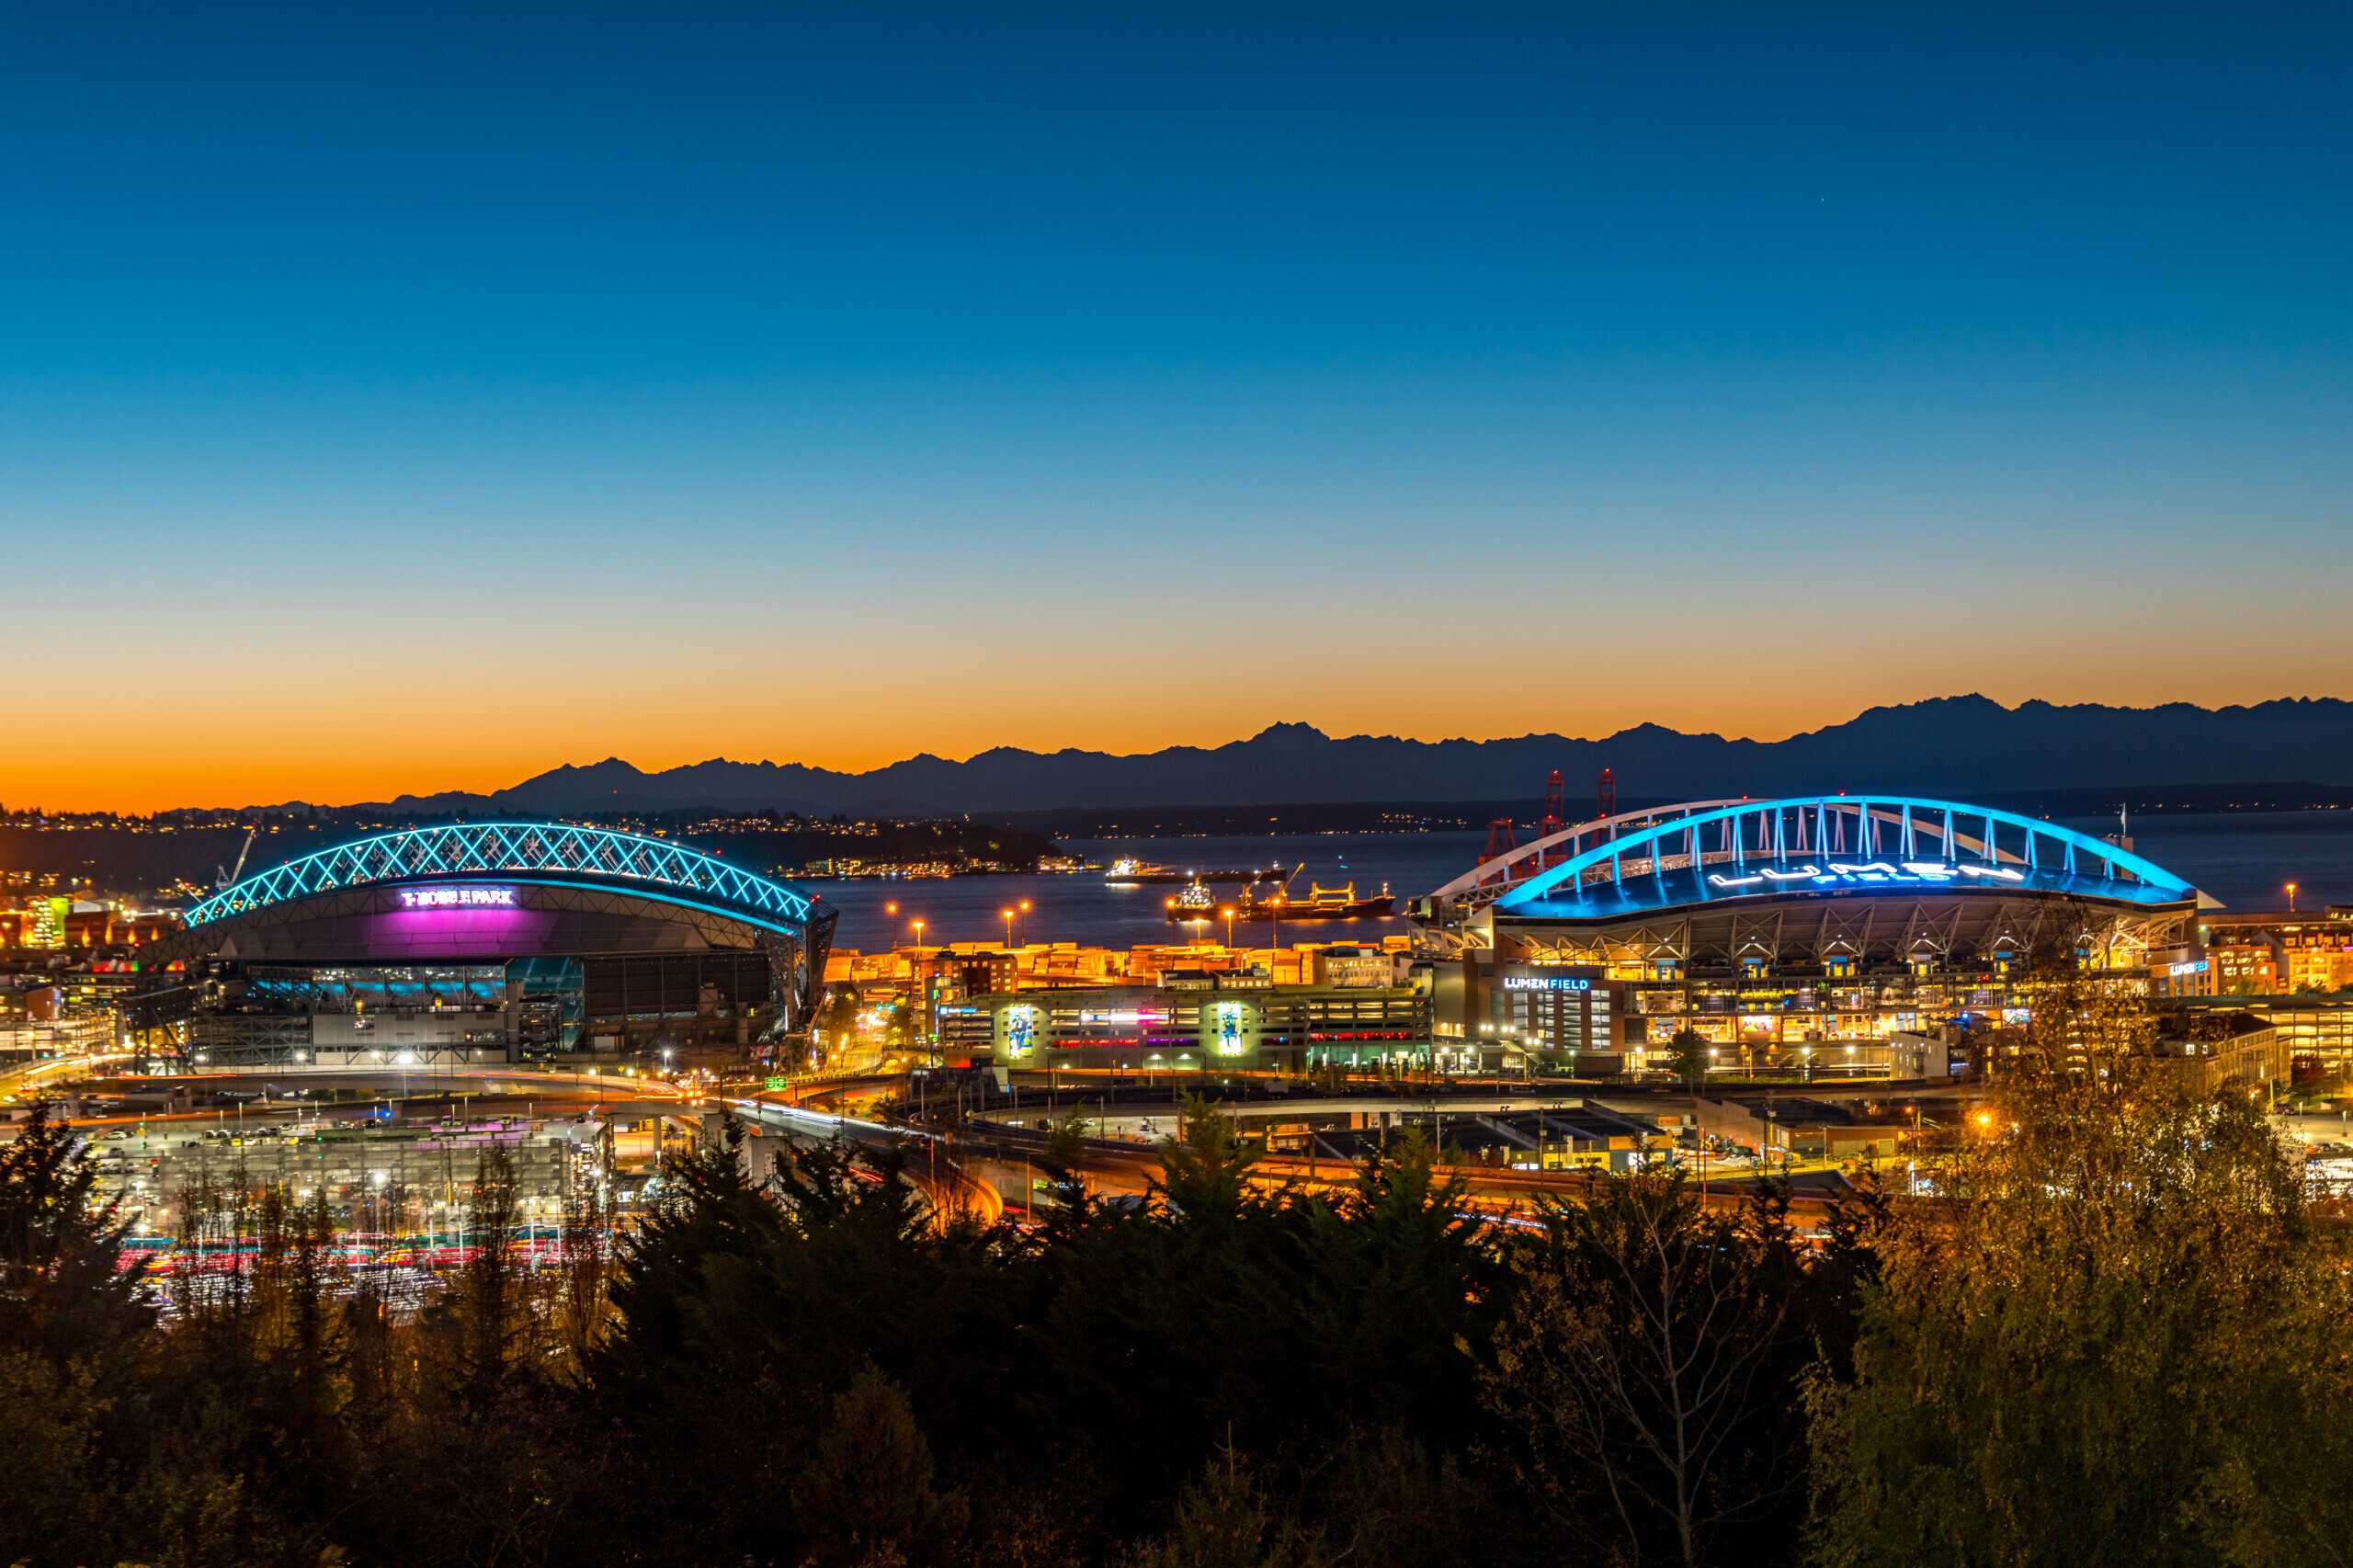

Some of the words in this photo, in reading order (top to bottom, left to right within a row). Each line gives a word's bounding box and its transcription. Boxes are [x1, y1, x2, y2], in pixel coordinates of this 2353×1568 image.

[1708, 862, 2025, 886] LUMEN
[1812, 873, 1951, 884] FIELD
[401, 890, 472, 906] T-MOBILE
[472, 889, 513, 904] PARK
[1504, 977, 1550, 989] LUMEN
[1550, 978, 1589, 990] FIELD
